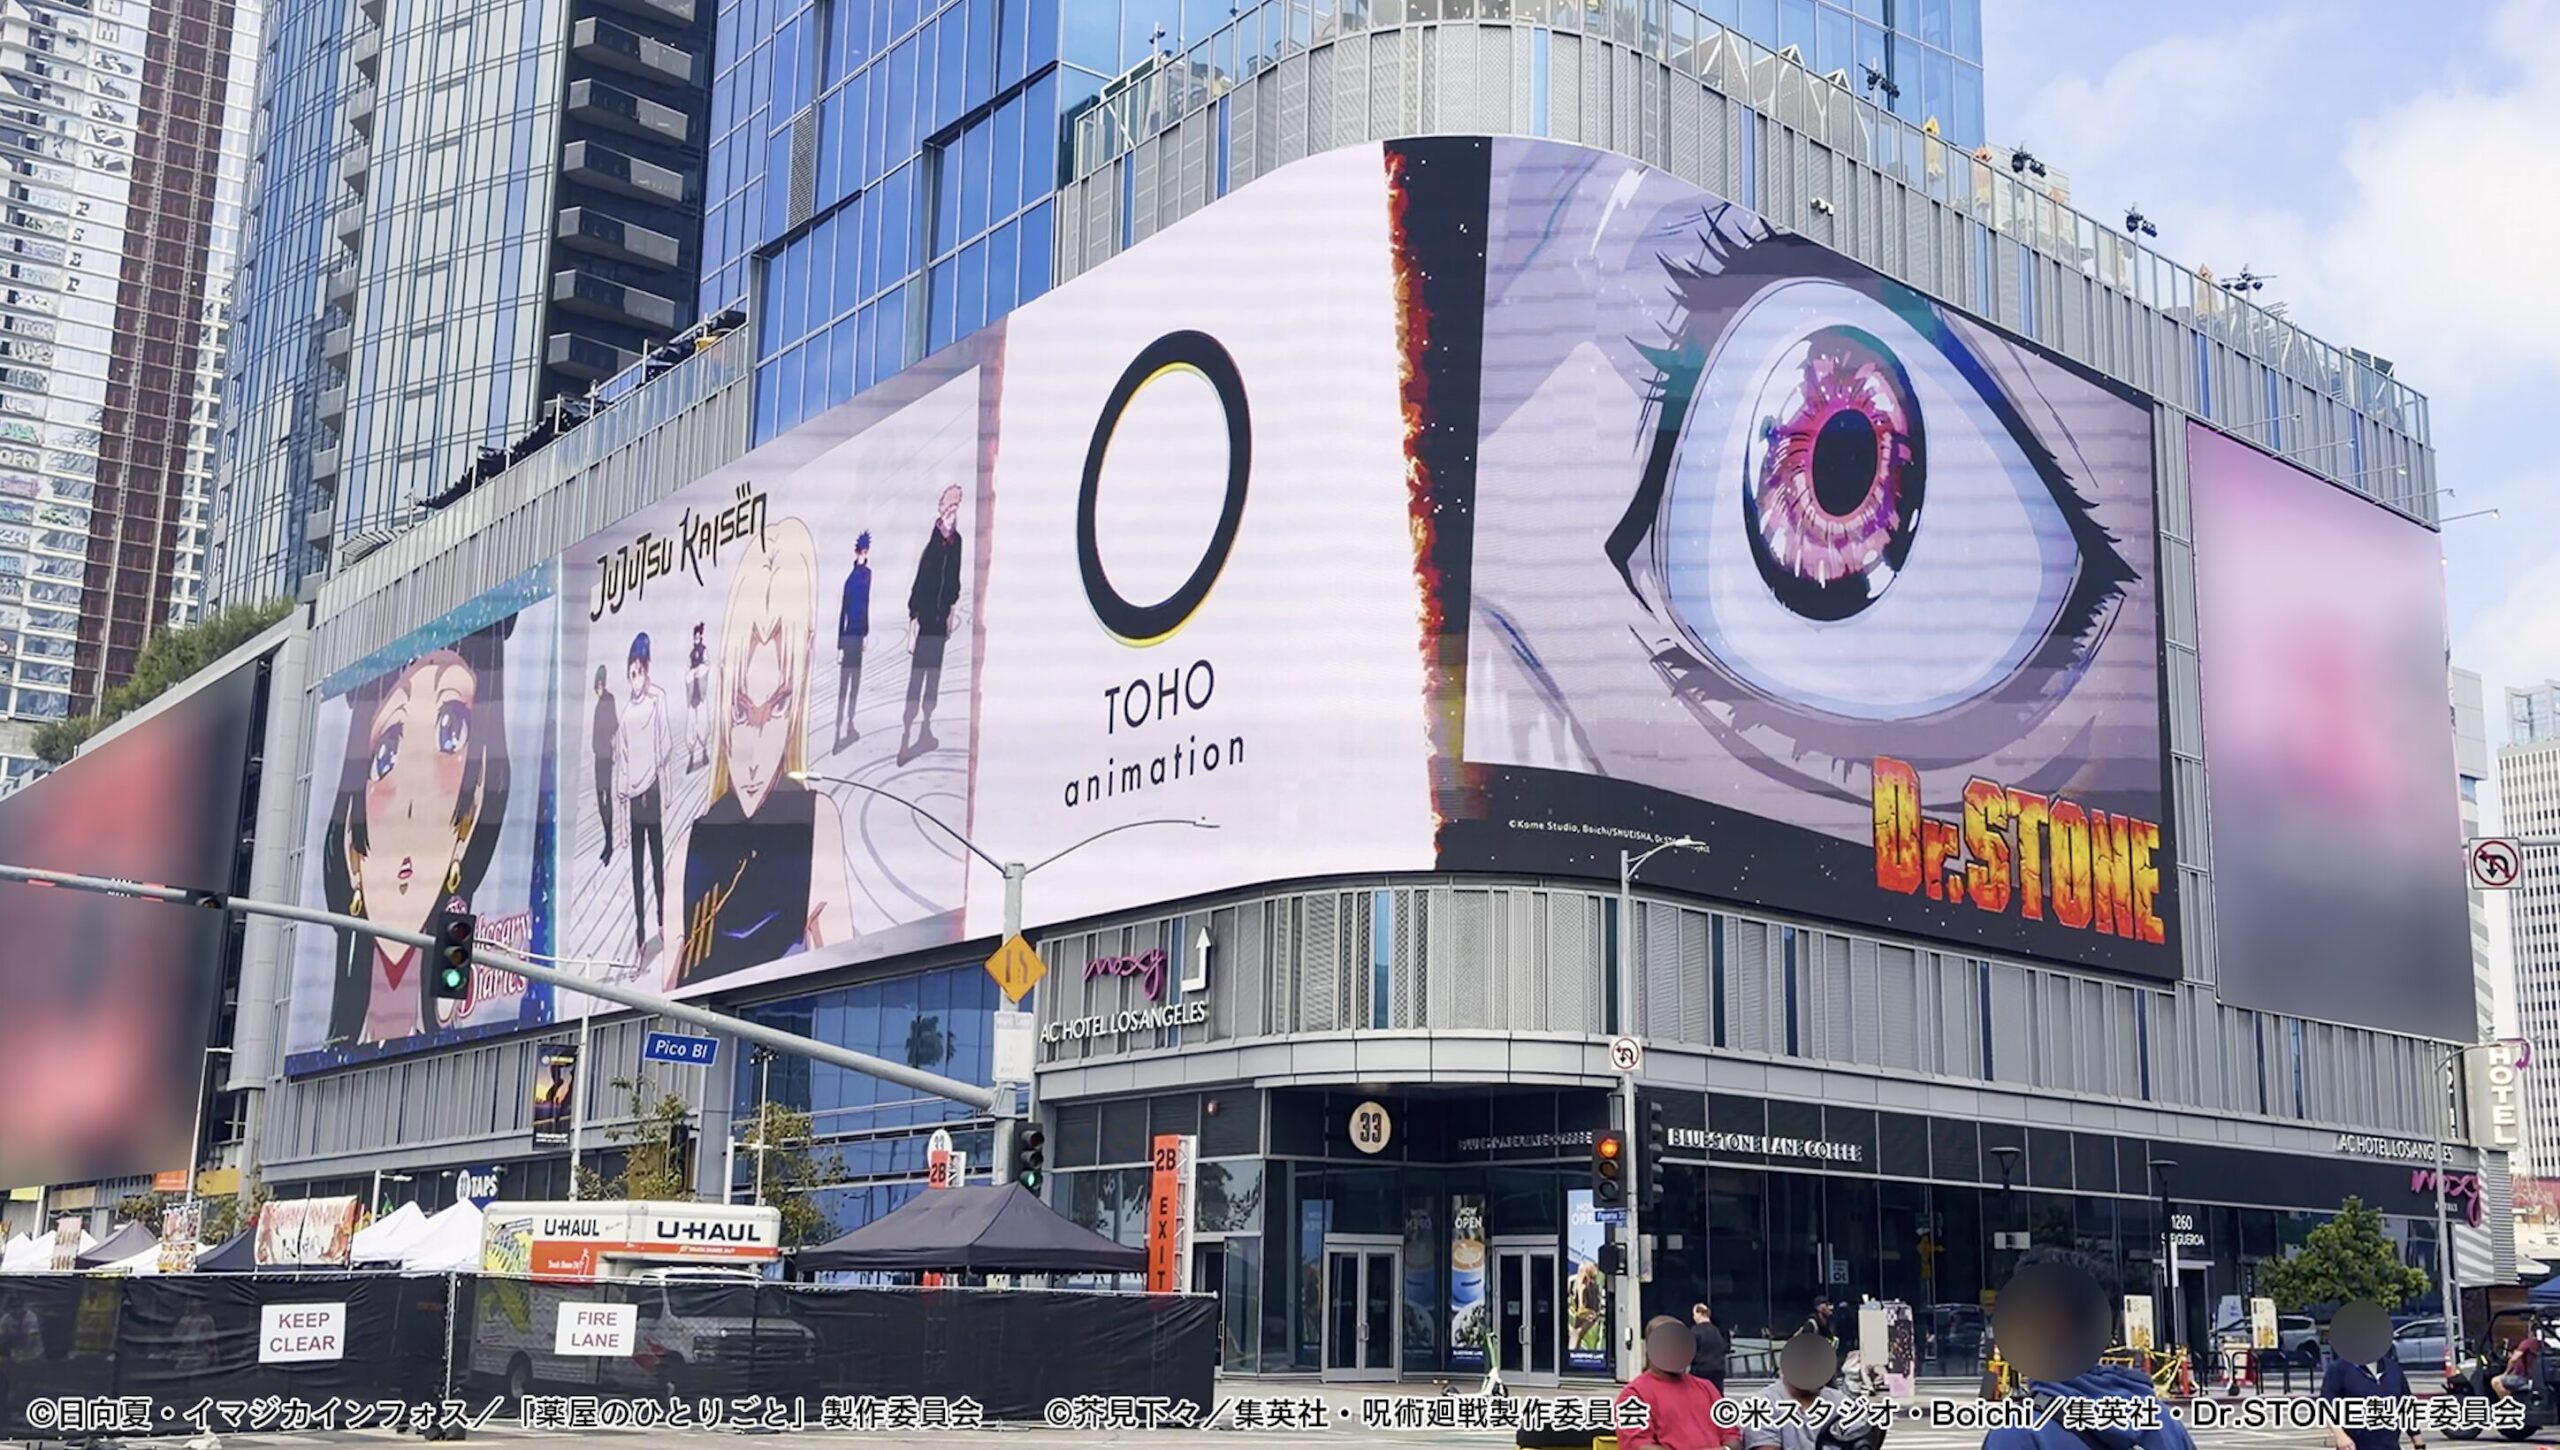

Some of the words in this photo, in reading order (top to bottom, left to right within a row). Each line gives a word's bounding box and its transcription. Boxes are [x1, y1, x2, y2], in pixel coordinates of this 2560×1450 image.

[590, 533, 672, 622] JUJUTSU
[1104, 659, 1214, 734] TOHO
[1064, 735, 1244, 807] animation
[1872, 755, 2165, 944] Dr.STONE
[1040, 1022, 1059, 1044] AC
[1062, 1016, 1107, 1040] HOTEL
[655, 1040, 687, 1057] Pico
[692, 1045, 708, 1059] Bl
[2488, 1046, 2518, 1145] HOTEL
[1360, 1112, 1382, 1143] 33
[1667, 1128, 1761, 1153] BLUESTONE
[2337, 1134, 2355, 1152] AC
[2357, 1136, 2391, 1156] HOTEL
[2412, 1142, 2453, 1162] ANGES
[1155, 1148, 1176, 1171] 2B
[930, 1163, 946, 1183] 2B
[471, 1174, 498, 1197] TAPS
[544, 1218, 600, 1237] U-HAUL
[1455, 1216, 1482, 1229] OPEN
[1571, 1212, 1595, 1226] OPE
[2171, 1215, 2193, 1230] 1260
[657, 1220, 762, 1242] U-HAUL
[1157, 1197, 1168, 1290] EXIT
[279, 1312, 330, 1328] KEEP
[578, 1311, 618, 1327] FIRE
[270, 1335, 335, 1353] CLEAR
[571, 1332, 620, 1349] LANE
